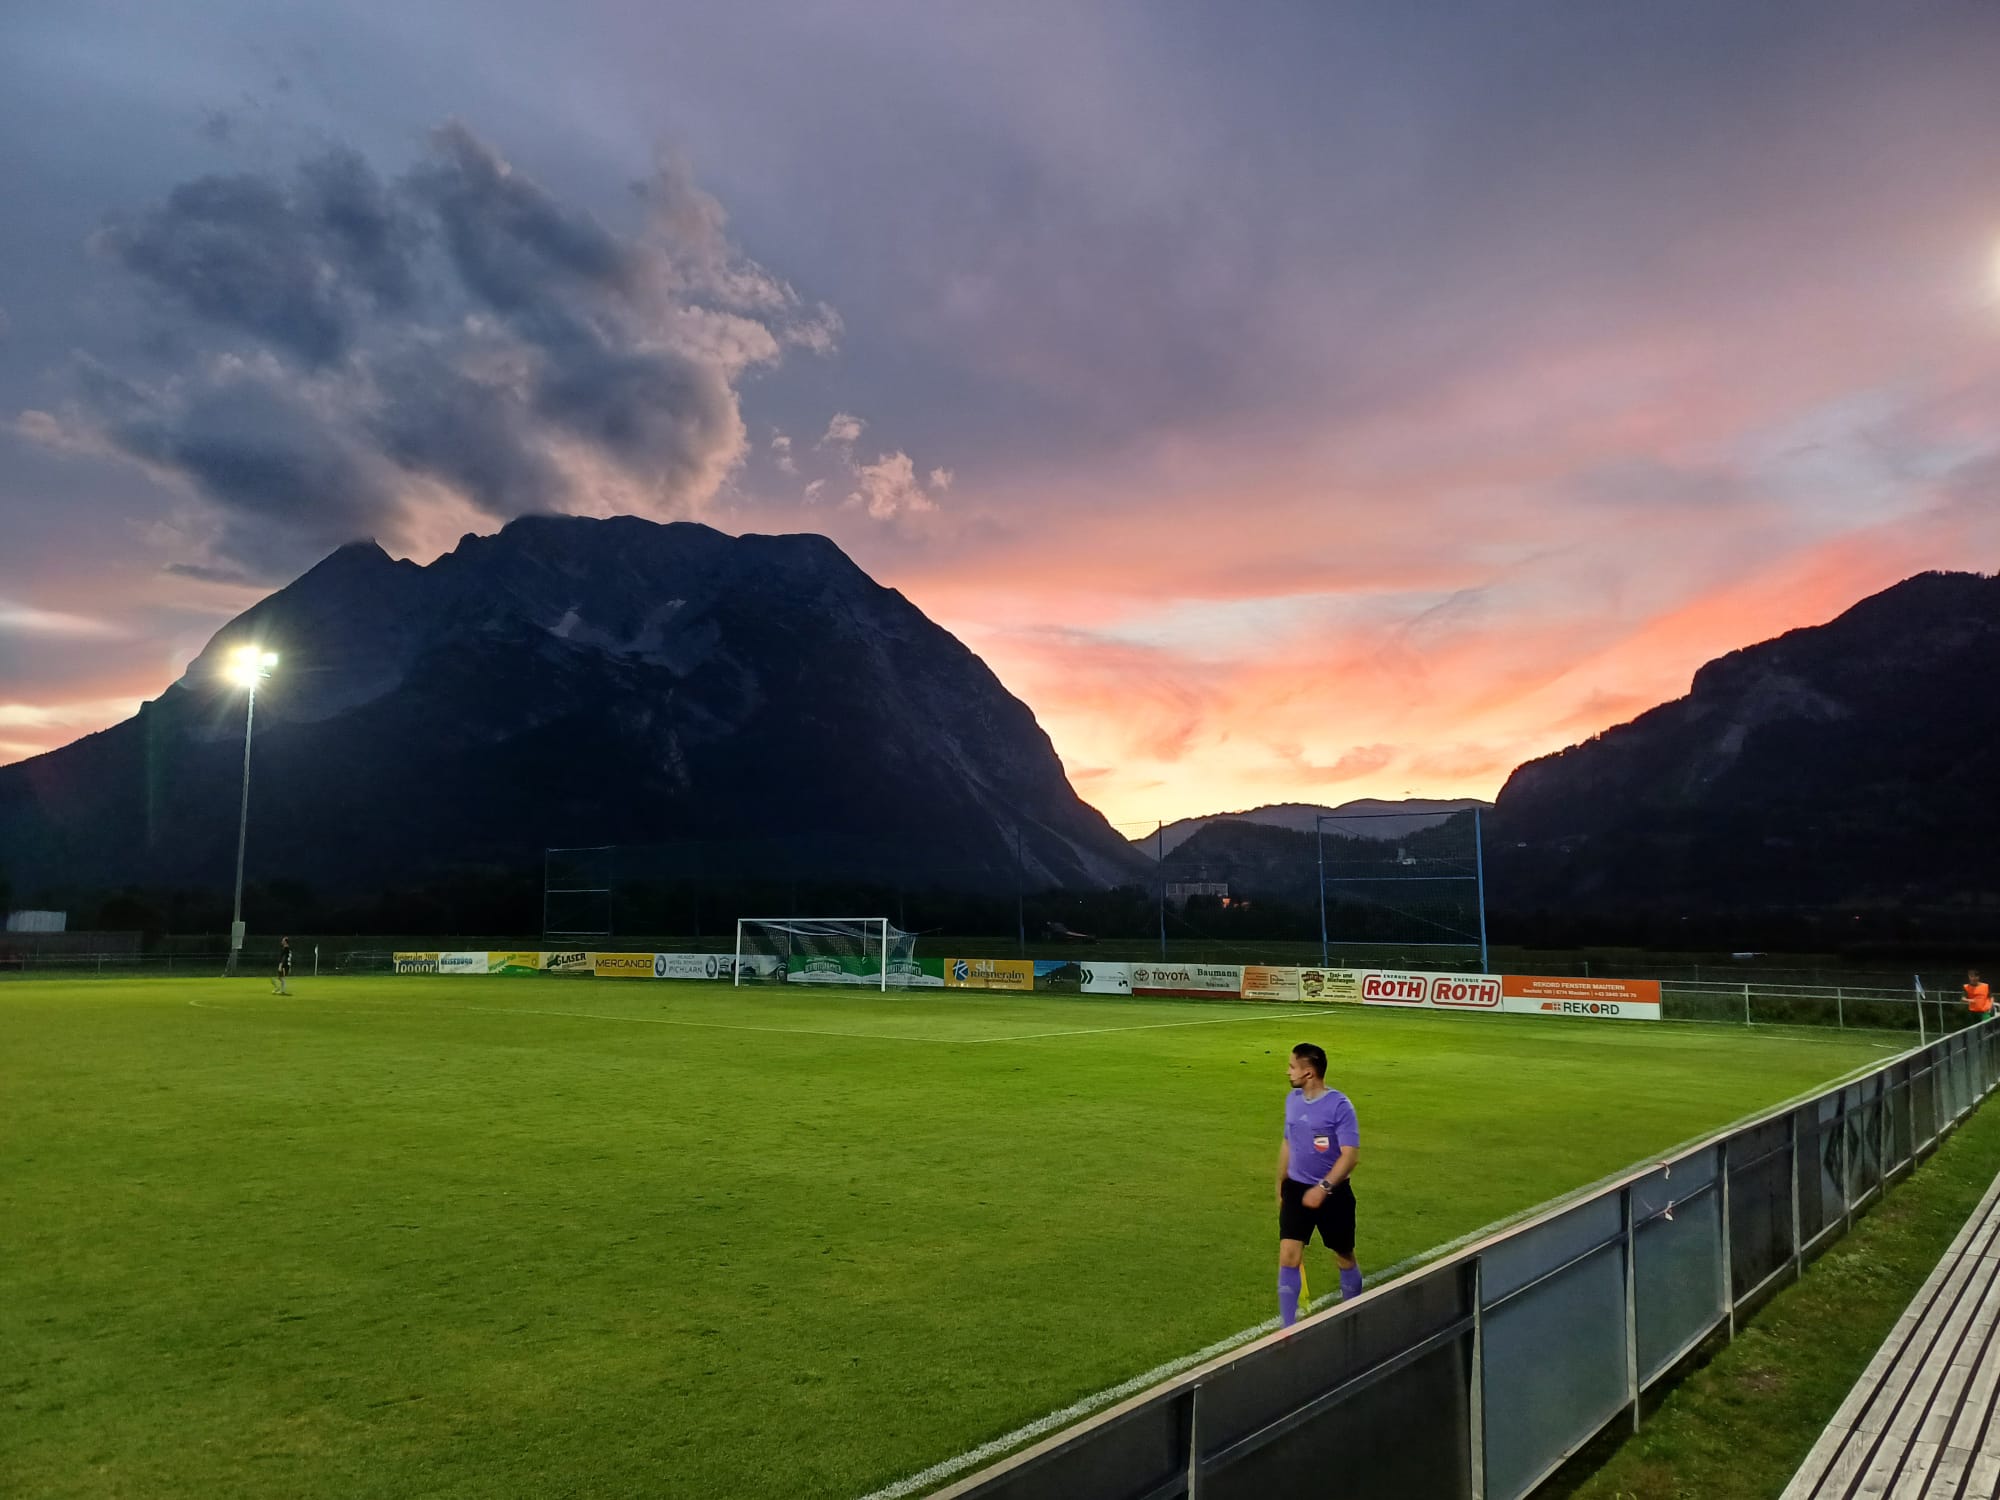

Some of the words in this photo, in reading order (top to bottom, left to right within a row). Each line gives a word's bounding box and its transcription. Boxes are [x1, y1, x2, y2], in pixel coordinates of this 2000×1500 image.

[556, 953, 586, 966] GLASER
[595, 959, 652, 969] MERCANDO
[668, 966, 702, 974] PICHLARN
[1197, 968, 1238, 978] Baumann
[1152, 971, 1190, 982] TOYOTA
[1366, 980, 1422, 998] ROTH
[1436, 984, 1495, 1002] ROTH
[1563, 1002, 1620, 1014] REKORD
